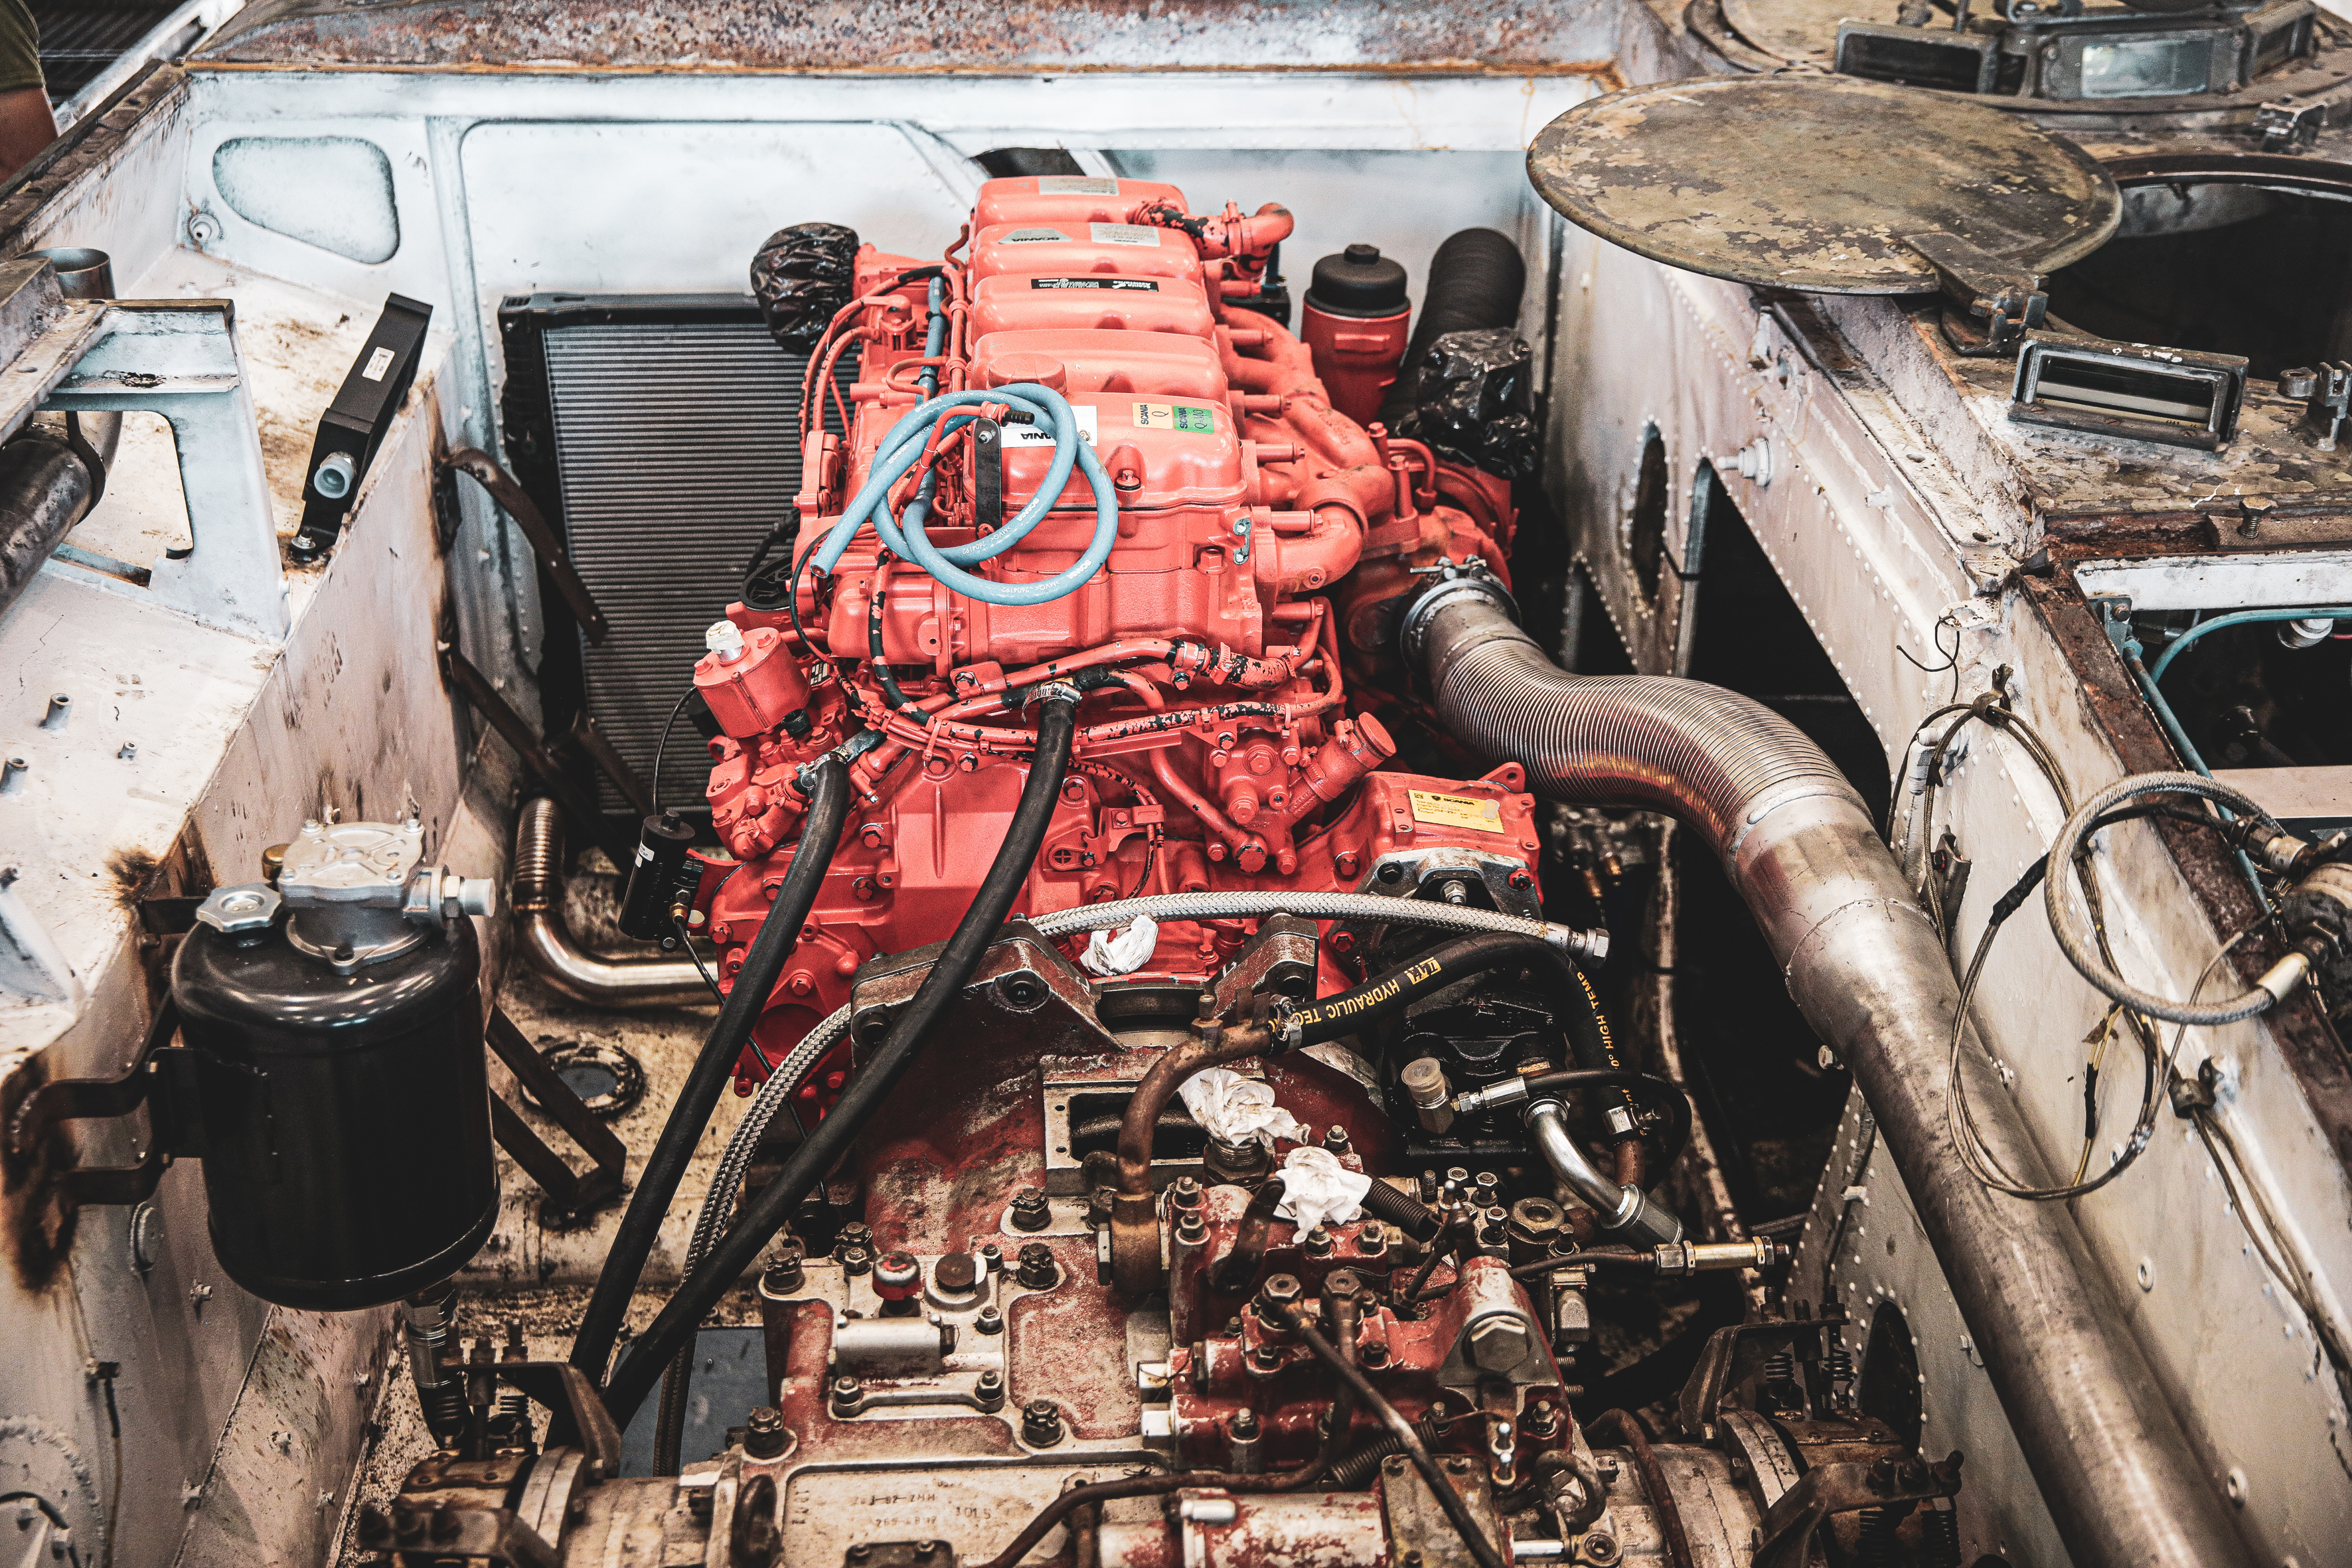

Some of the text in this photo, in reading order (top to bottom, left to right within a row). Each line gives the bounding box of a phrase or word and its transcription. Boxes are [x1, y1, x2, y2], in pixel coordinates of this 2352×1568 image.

[1140, 404, 1148, 425] SCANIA
[1179, 407, 1188, 430] SCANIA
[1016, 497, 1040, 522] SCANIA
[962, 540, 986, 554] 2604192
[1066, 559, 1093, 580] SCANIA
[1327, 979, 1401, 1019] HYDRAULIC
[1577, 971, 1599, 1009] TEMP
[1596, 1014, 1614, 1049] HIGH
